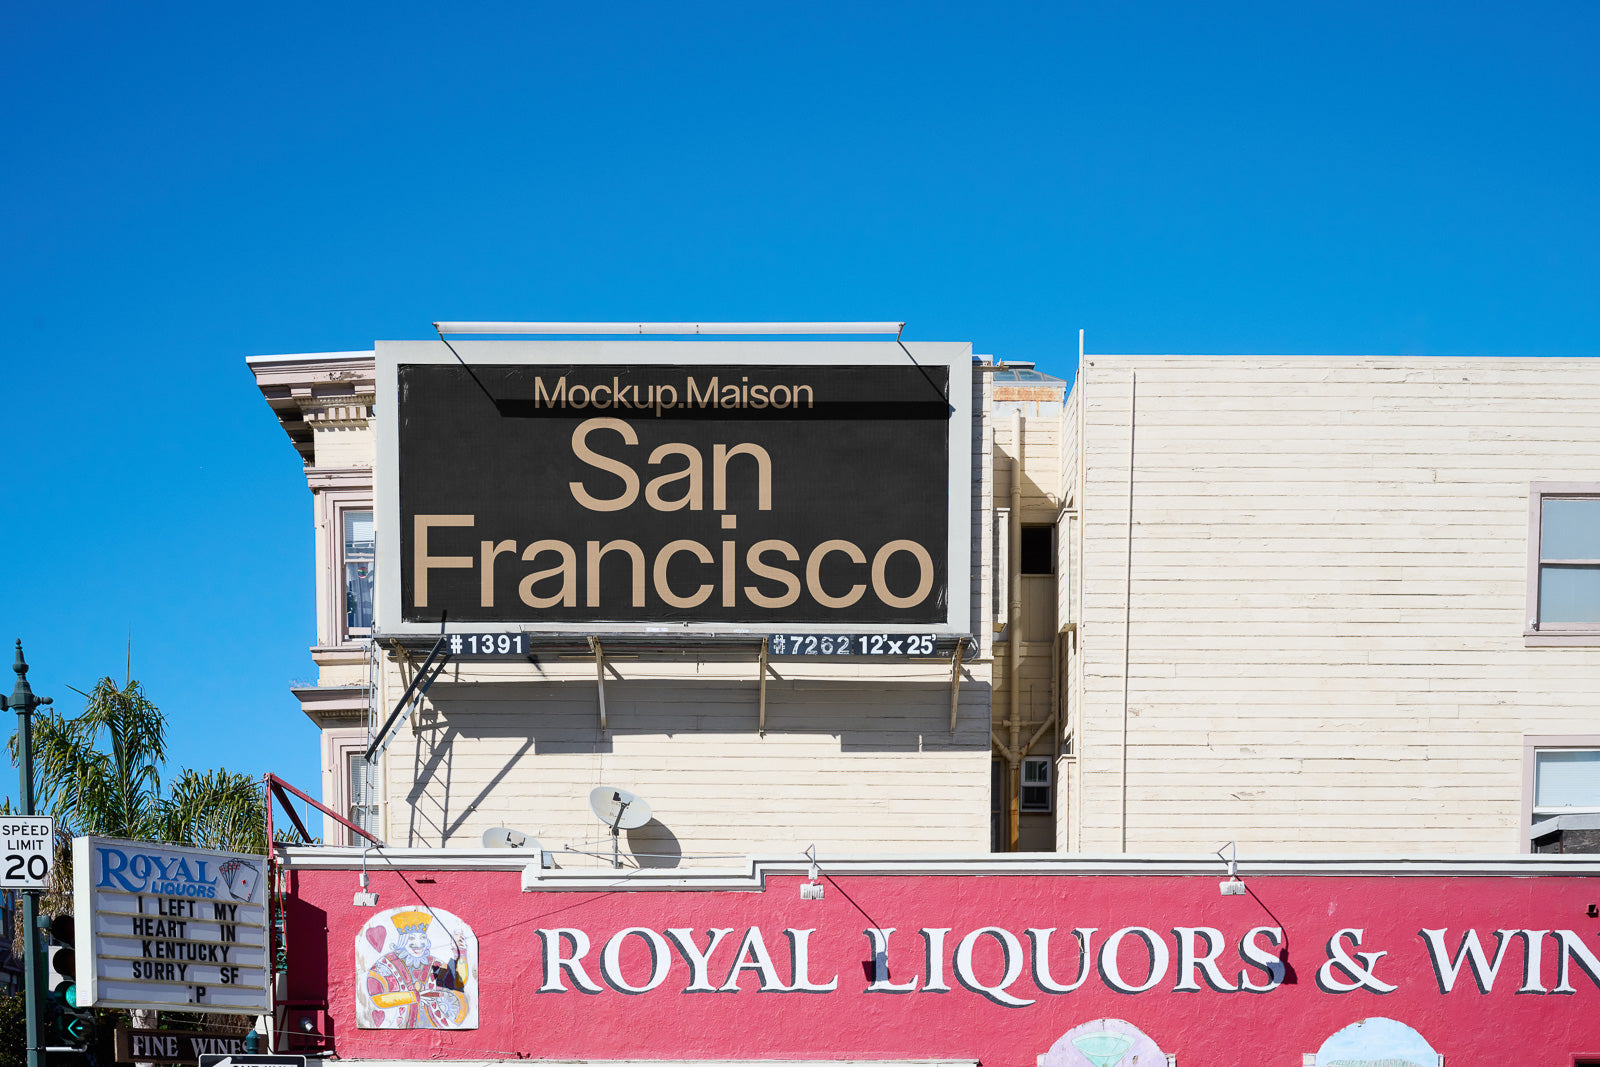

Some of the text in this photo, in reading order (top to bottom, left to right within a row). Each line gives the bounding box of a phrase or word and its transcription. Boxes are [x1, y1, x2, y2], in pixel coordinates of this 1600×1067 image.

[533, 376, 814, 417] Mockup.Maison
[568, 417, 772, 512] San
[413, 514, 934, 609] Francisco
[450, 634, 522, 654] #1391
[2, 825, 49, 836] SPEED
[7, 839, 44, 850] LIMIT
[5, 854, 48, 880] 20
[96, 847, 218, 892] ROYAL
[151, 880, 216, 899] LIQUORS
[138, 895, 238, 922] I LEFT MY
[132, 917, 236, 942] HEART IN
[142, 939, 230, 963] KENTUCKY
[132, 960, 239, 985] SORRY SF
[535, 926, 839, 994] ROYAL
[862, 926, 1286, 1008] LIQUORS
[1315, 927, 1399, 995] &
[132, 1035, 179, 1057] FINE
